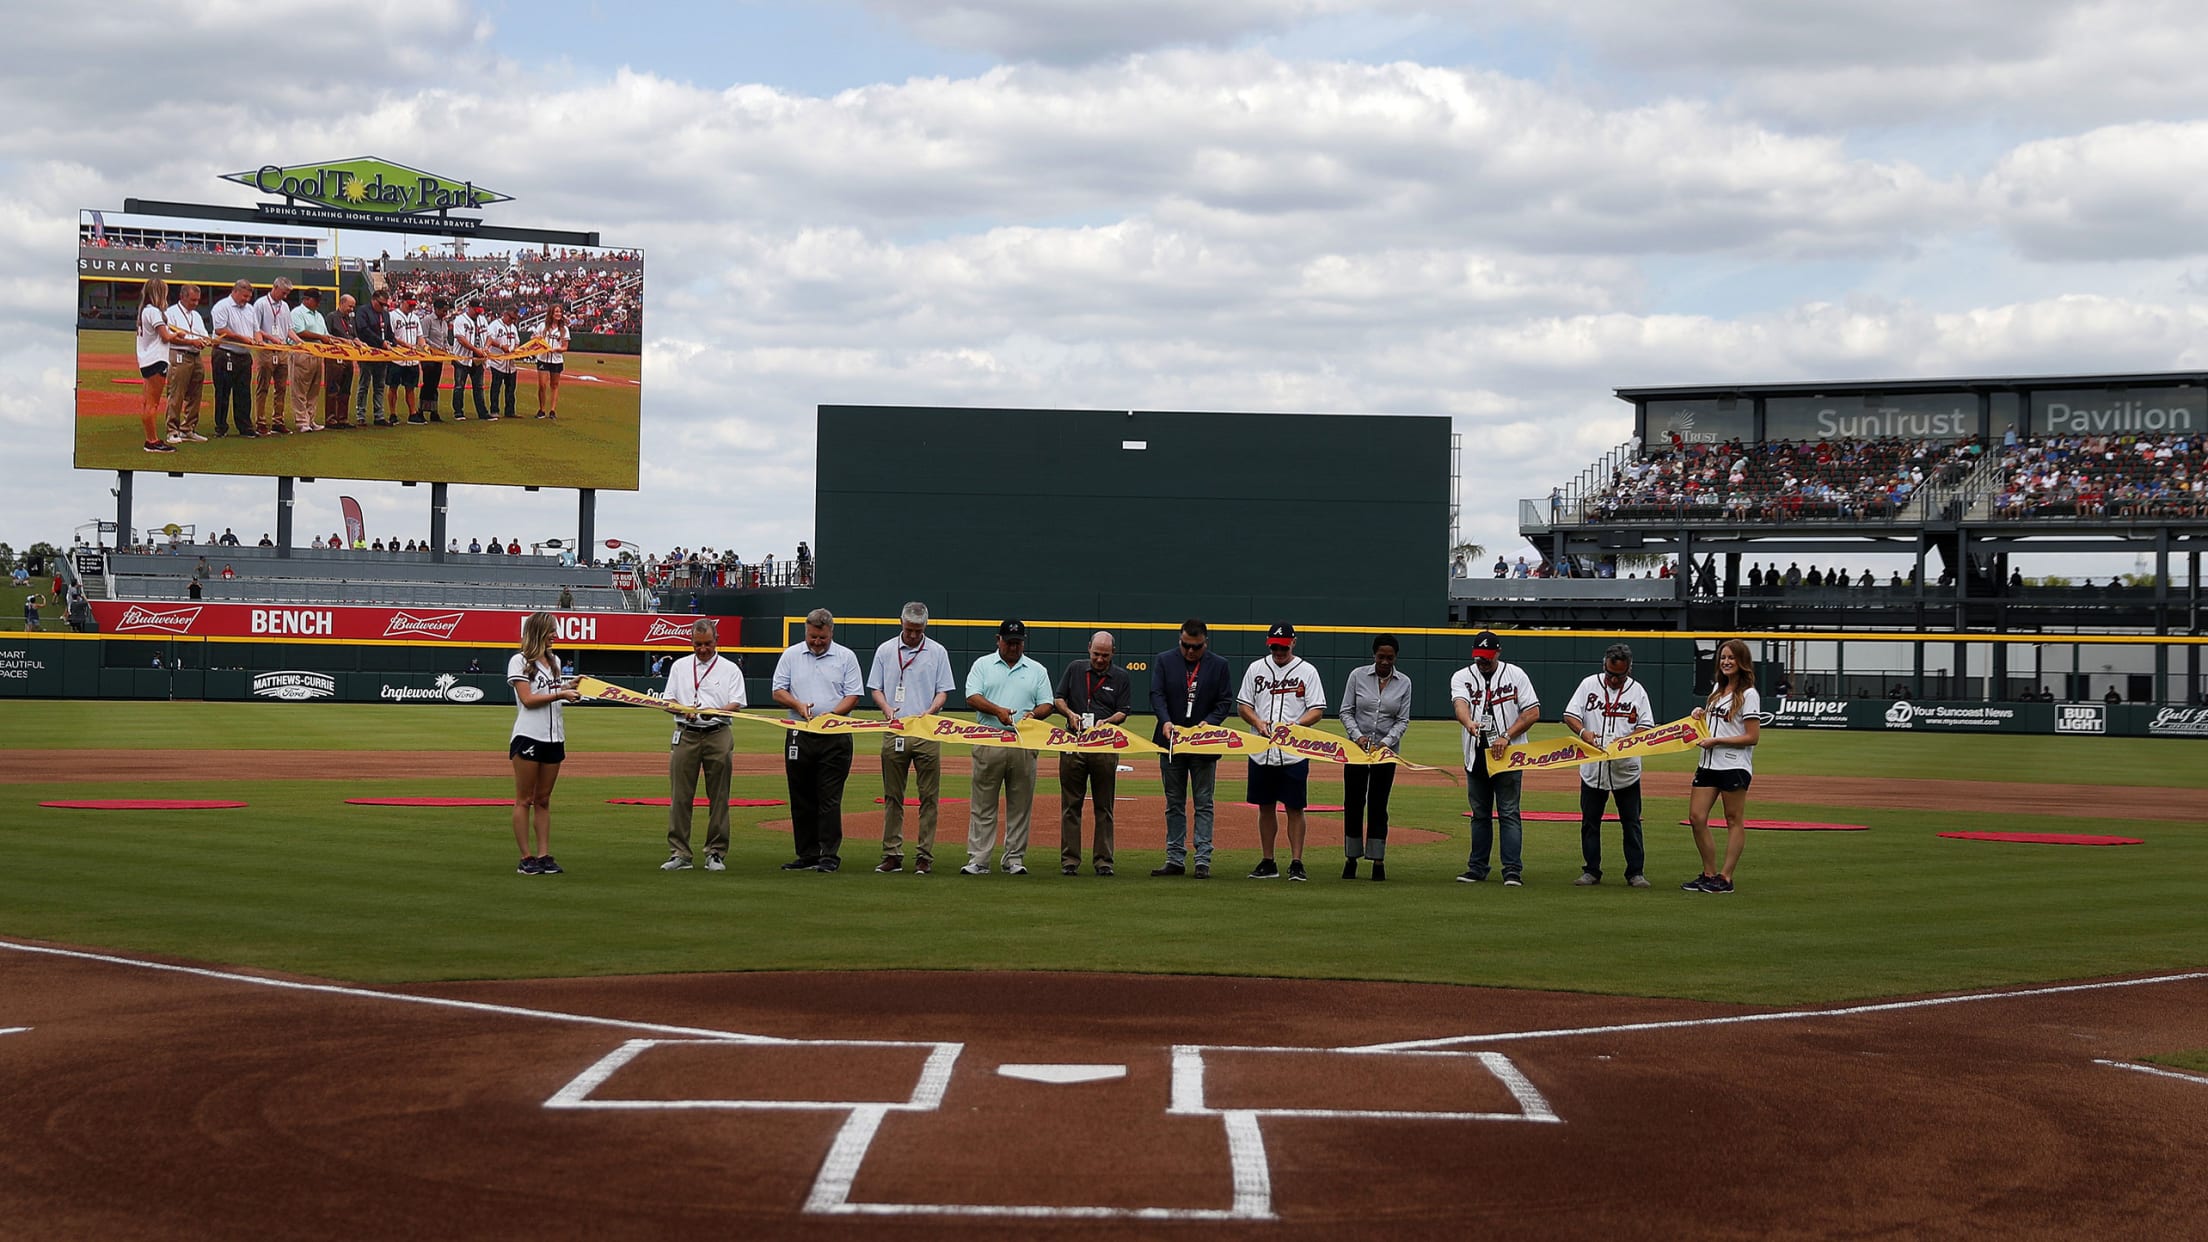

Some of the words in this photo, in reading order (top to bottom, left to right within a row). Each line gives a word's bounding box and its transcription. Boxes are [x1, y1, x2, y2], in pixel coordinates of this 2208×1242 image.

[416, 177, 482, 209] Park
[265, 207, 297, 216] SPRING
[301, 209, 343, 219] TRAINING
[346, 213, 371, 222] HOME
[402, 217, 441, 226] ATLANTA
[443, 220, 475, 229] BRAVES
[80, 259, 173, 273] SURANCE
[1817, 408, 1966, 437] SunTrust
[2047, 402, 2191, 432] Pavilion
[123, 610, 194, 626] Budweiser
[252, 610, 332, 634] BENCH
[390, 616, 455, 631] Budweiser
[1126, 662, 1147, 671] 400
[253, 675, 335, 691] MATTHEWS-CURRIE
[381, 684, 443, 701] Englewood
[1254, 675, 1300, 696] Braves
[1775, 697, 1848, 716] Juniper
[1913, 706, 1936, 716] Your
[1936, 706, 1984, 717] Suncoast
[1985, 708, 2014, 718] News
[2064, 708, 2096, 719] BUD
[2058, 719, 2103, 731] LIGHT
[2149, 707, 2197, 728] Gulf
[1269, 725, 1338, 753] Braves
[1618, 724, 1681, 751] Braves
[1508, 744, 1576, 768] Braves
